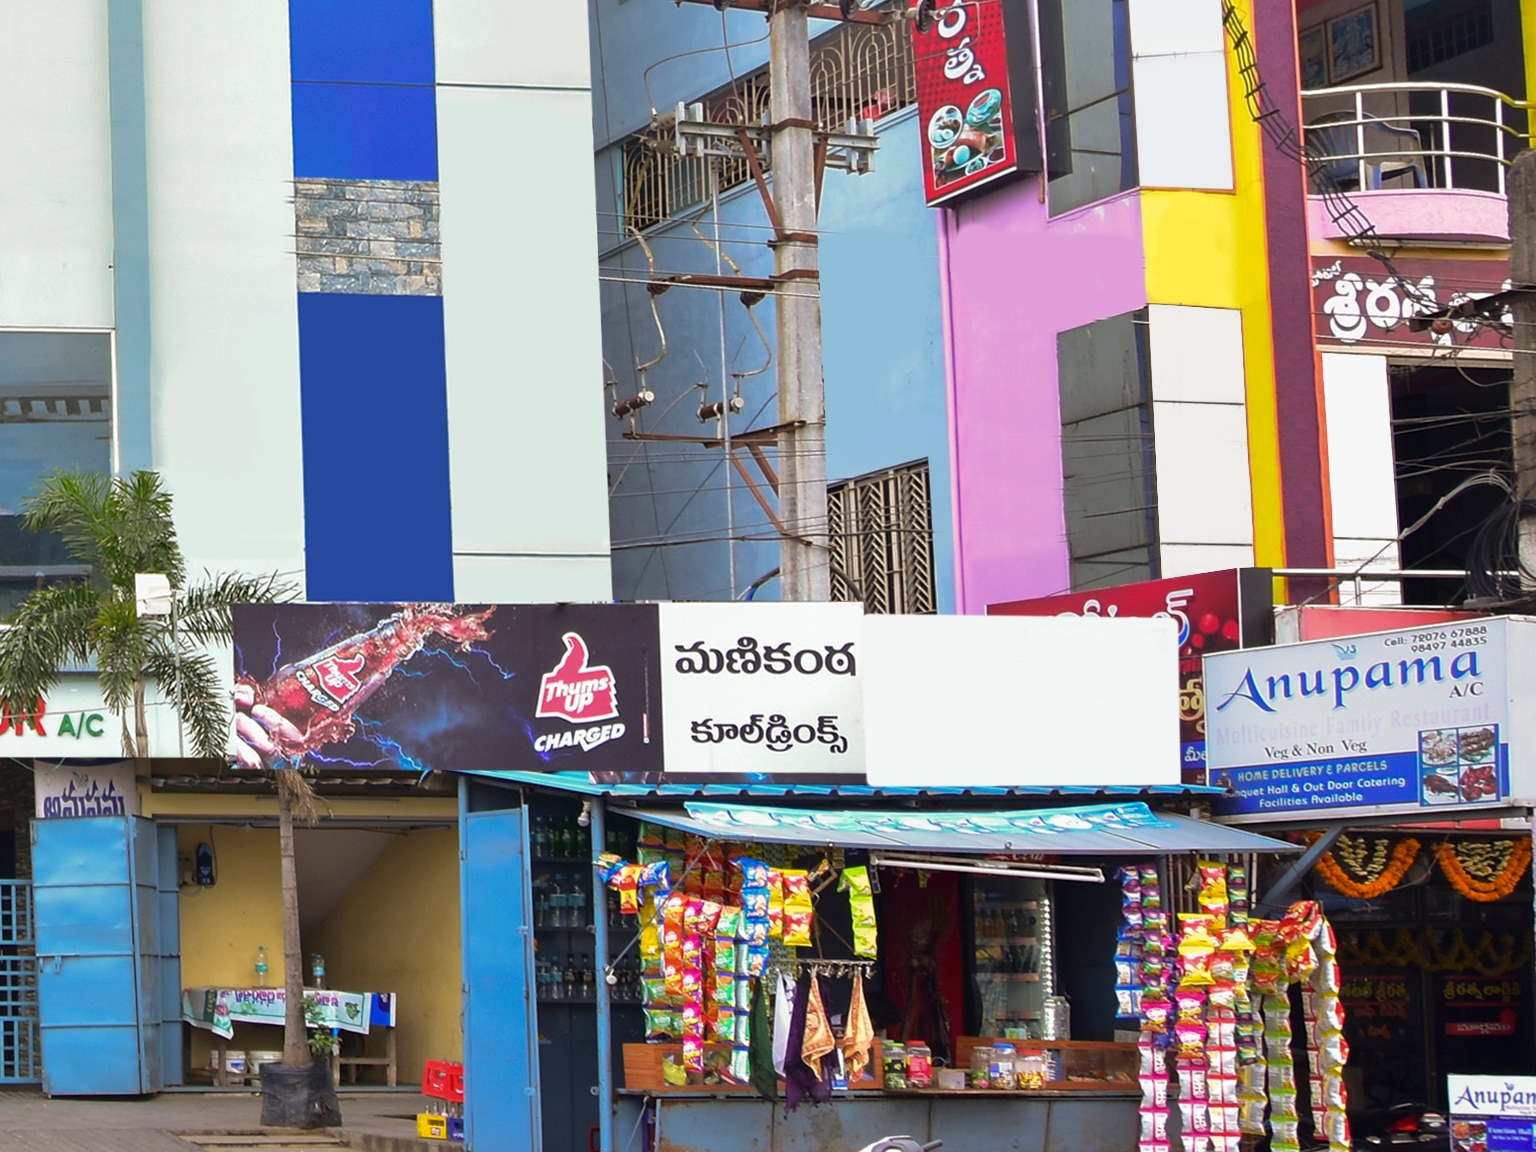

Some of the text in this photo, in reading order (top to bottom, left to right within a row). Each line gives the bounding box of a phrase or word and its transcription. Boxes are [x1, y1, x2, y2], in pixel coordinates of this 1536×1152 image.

[1384, 626, 1487, 647] Cell: 72076 67888
[1411, 637, 1487, 653] 98497 44835
[674, 636, 856, 676] మణికంఠ
[545, 677, 608, 703] Thums
[1216, 650, 1482, 712] Anupama
[1449, 681, 1483, 698] A/C
[58, 712, 104, 738] A/C
[1217, 703, 1490, 746] Multicuisine Family Restaurant
[534, 723, 625, 752] CHARGED
[1265, 739, 1367, 760] Veg & Non Veg
[1238, 769, 1269, 782] HOME
[1272, 765, 1323, 779] DELIVERY
[1336, 760, 1388, 774] PARCELS
[1267, 784, 1289, 796] Hall
[1291, 784, 1300, 793] &
[1303, 781, 1324, 792] Out
[1327, 780, 1353, 791] Door
[1357, 776, 1406, 789] Catering
[1259, 792, 1363, 808] Facilities Available
